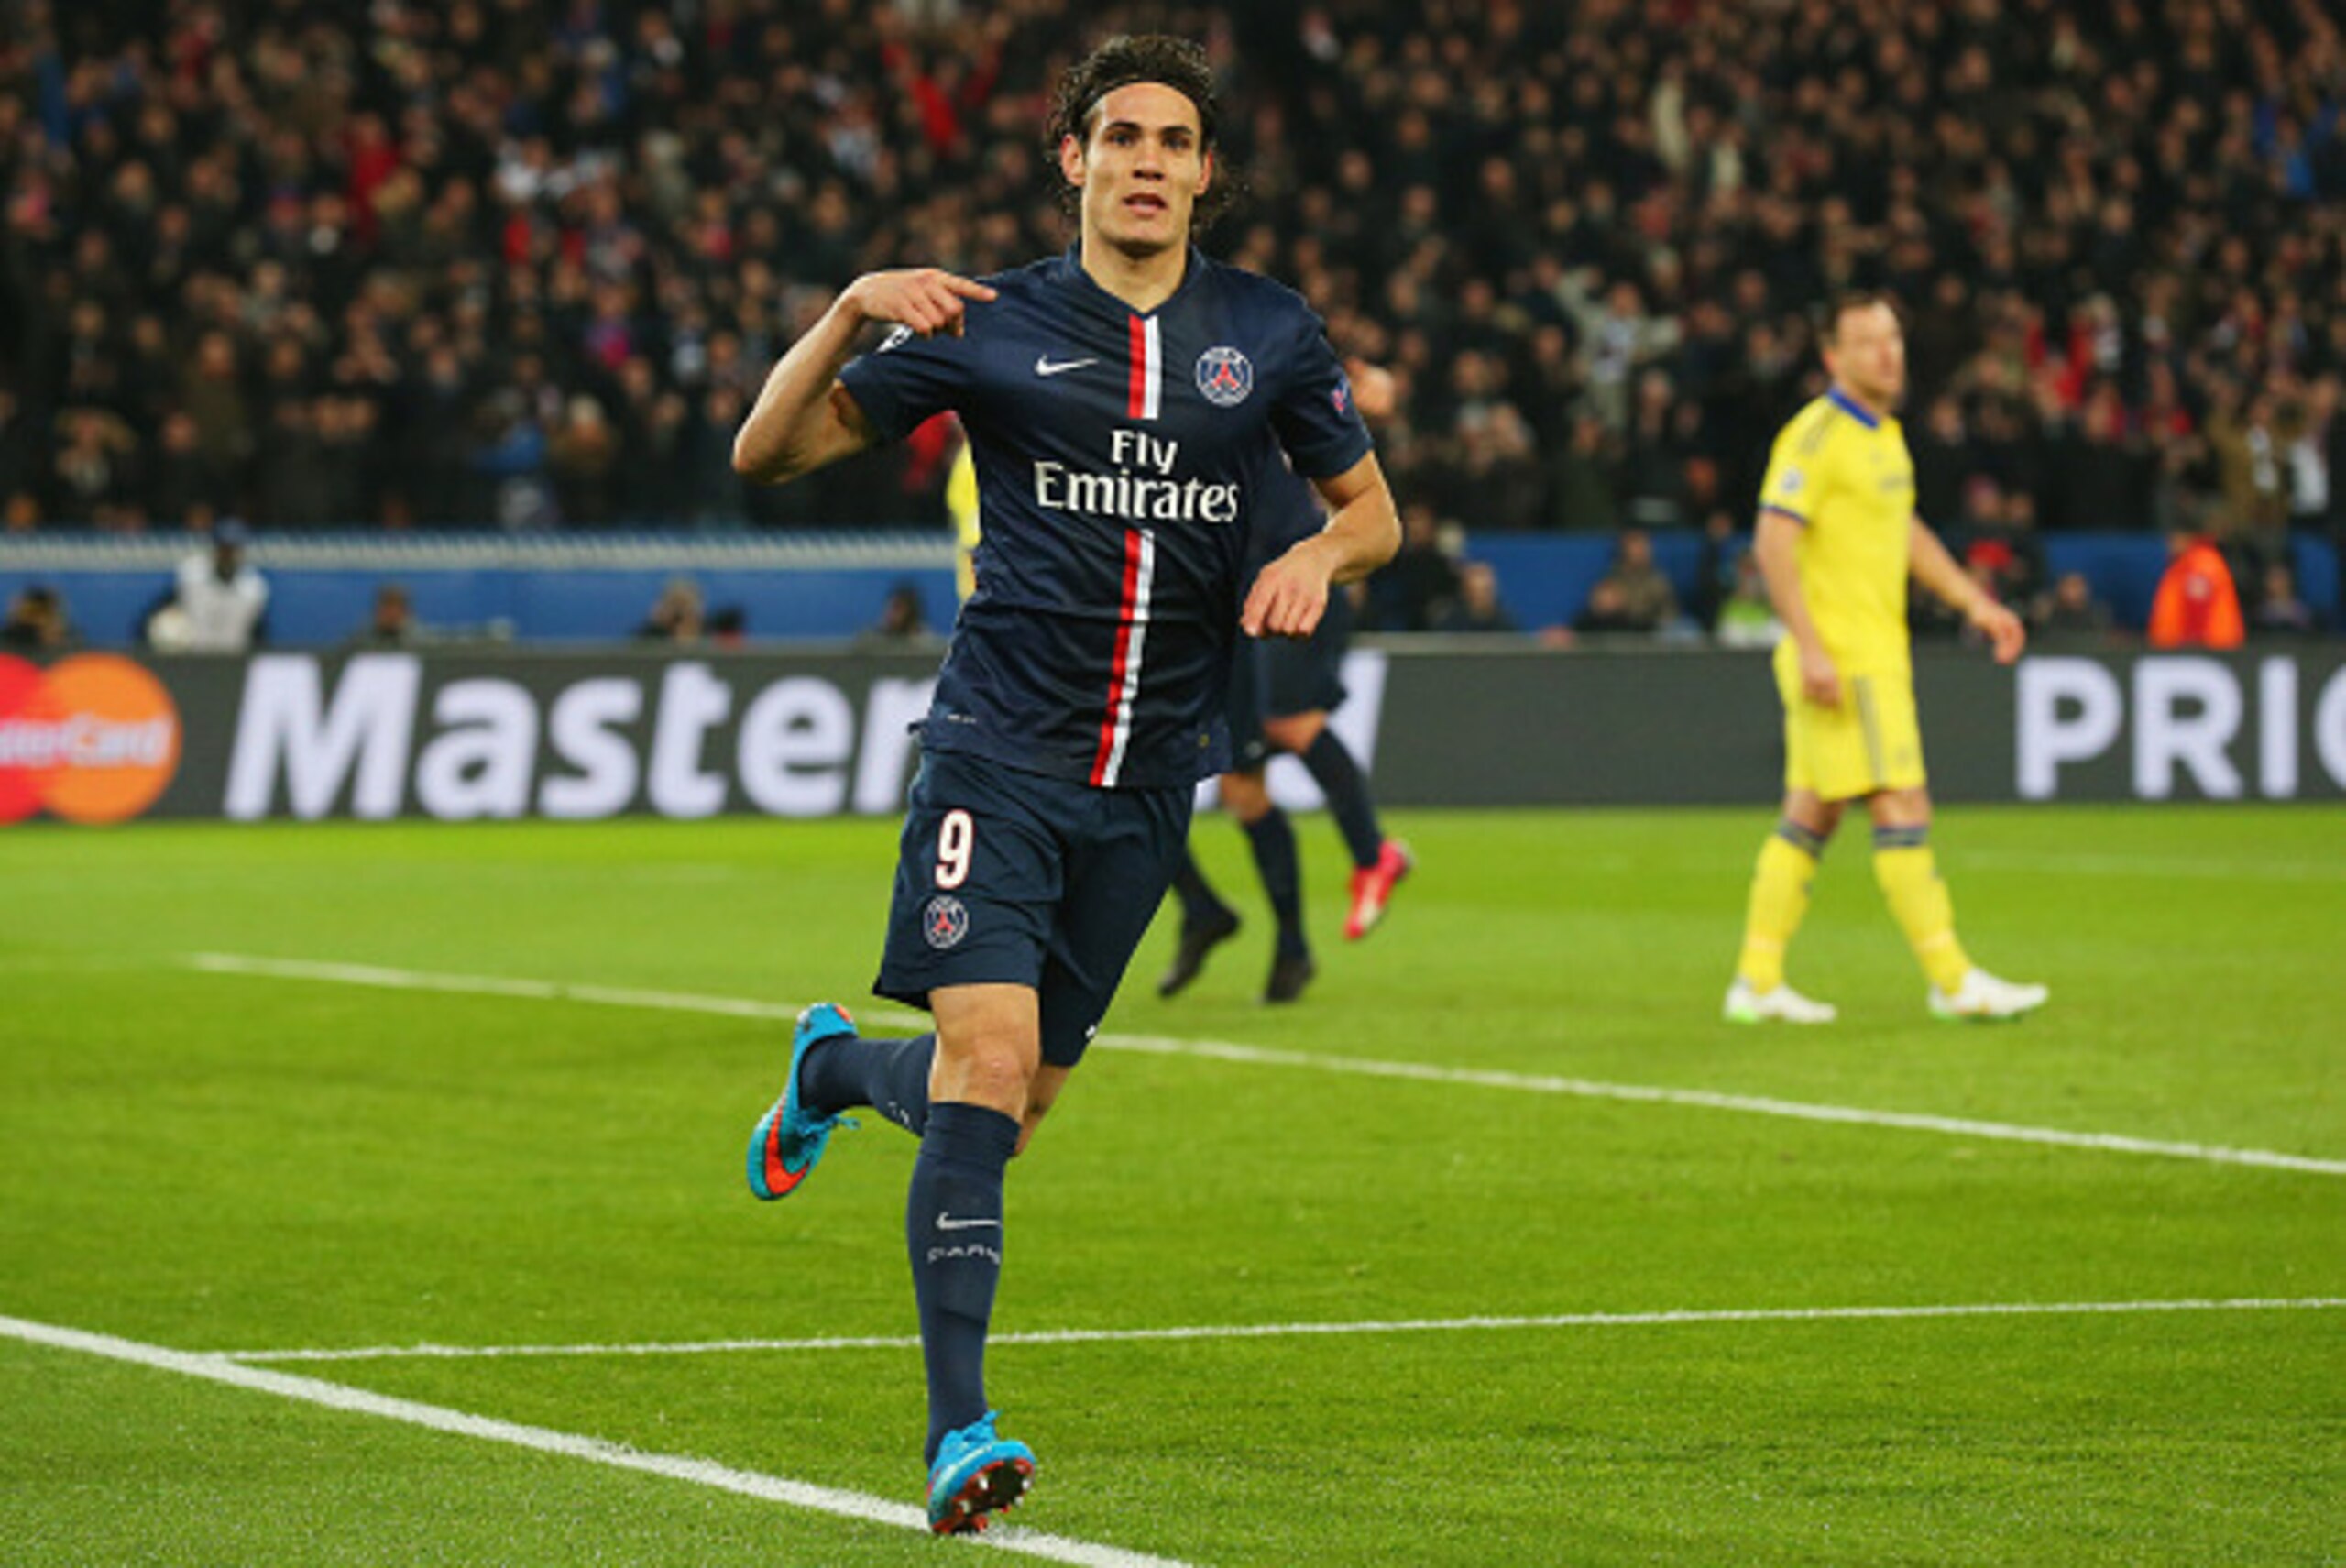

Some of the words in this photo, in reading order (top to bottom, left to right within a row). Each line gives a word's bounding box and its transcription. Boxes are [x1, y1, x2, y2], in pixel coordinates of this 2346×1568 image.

[1111, 429, 1178, 475] Fly
[1034, 460, 1239, 522] Emirates
[935, 808, 974, 889] 9
